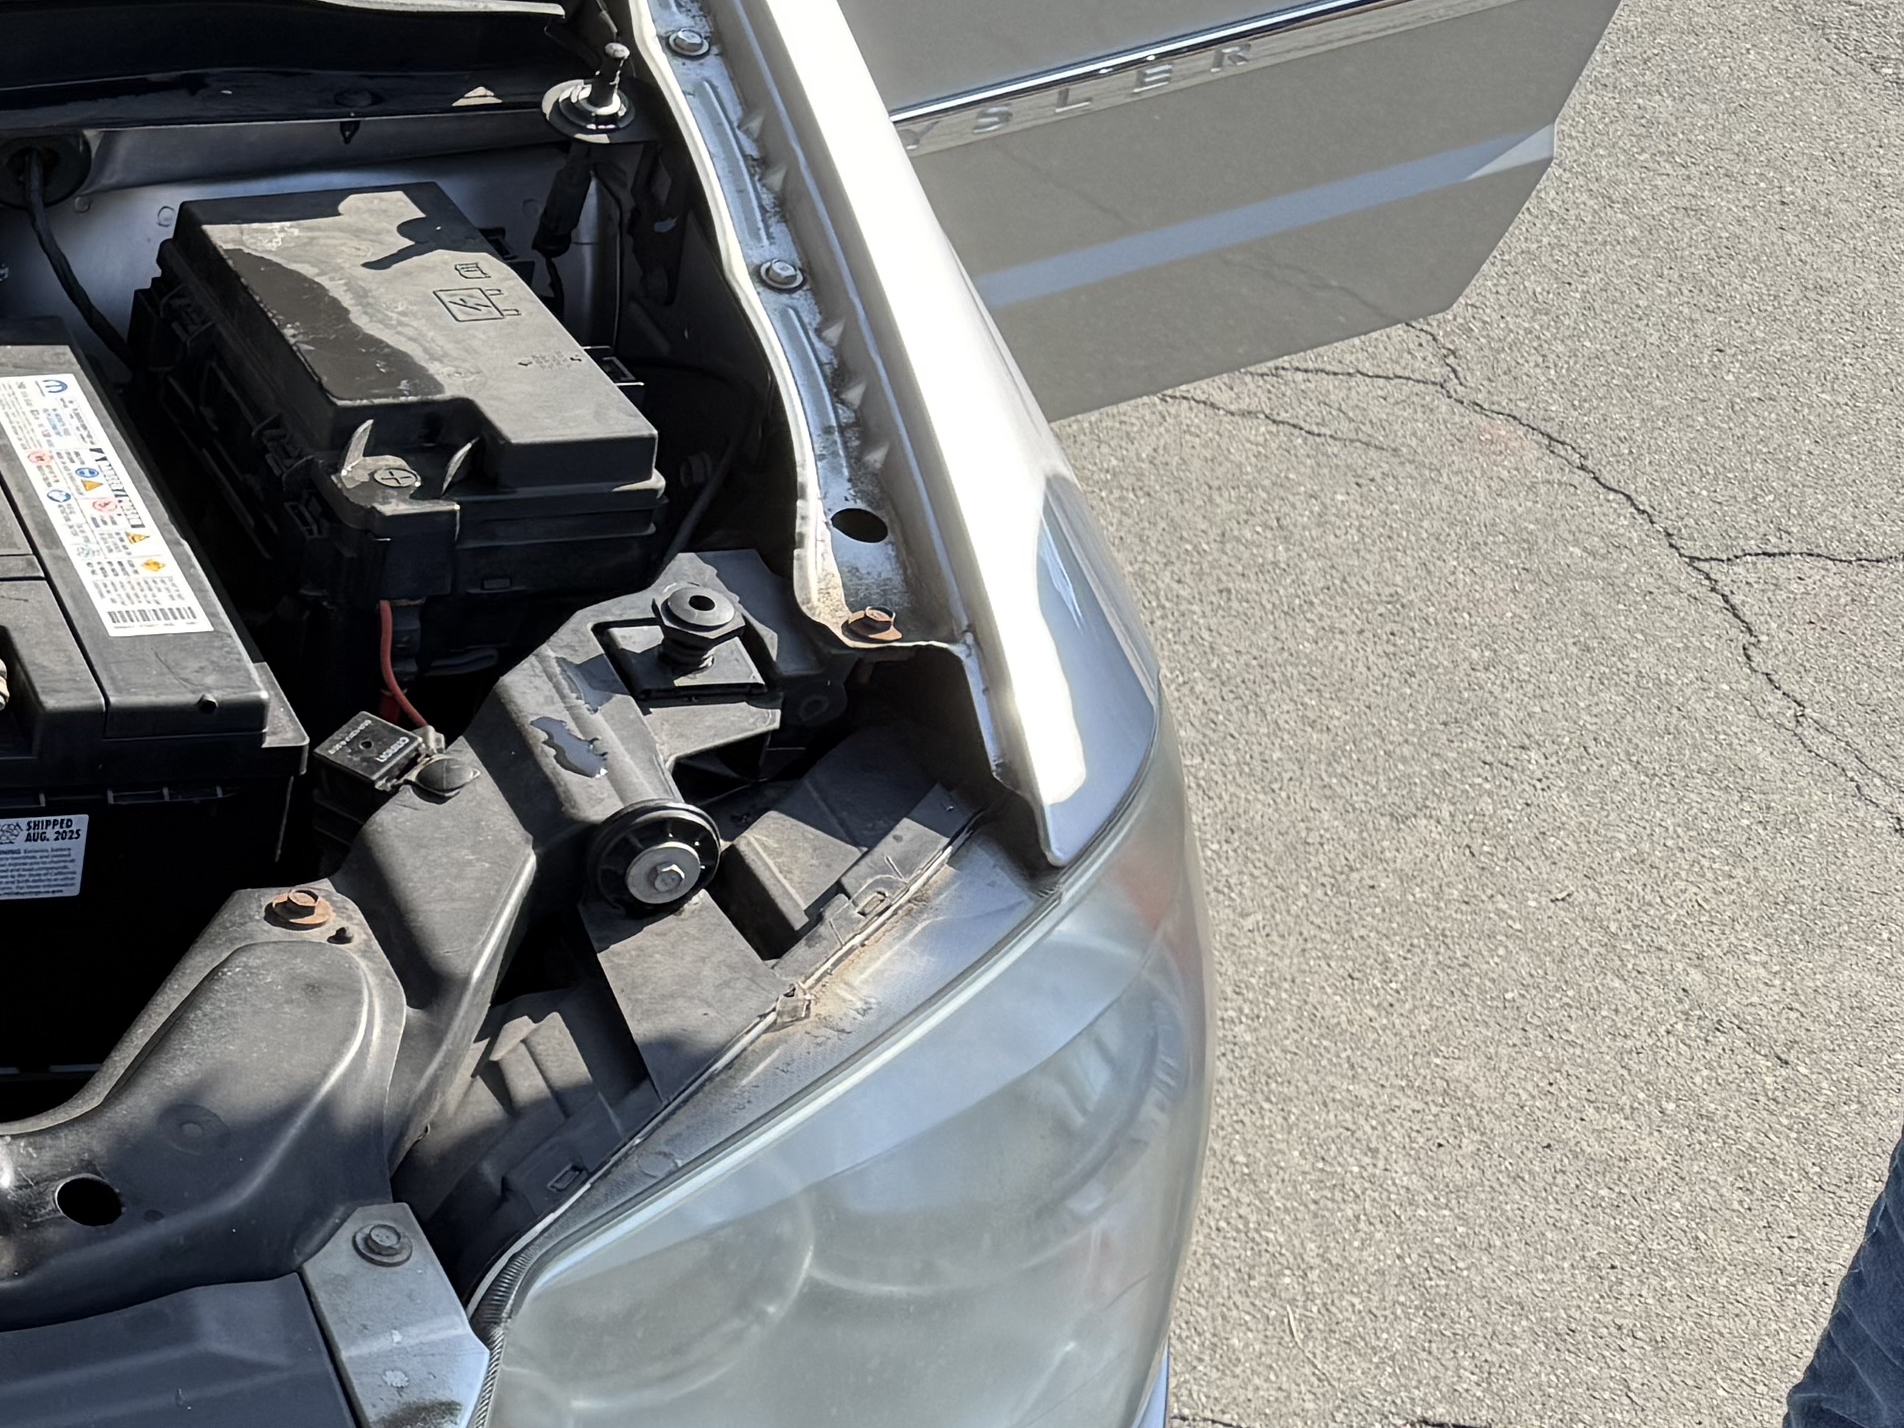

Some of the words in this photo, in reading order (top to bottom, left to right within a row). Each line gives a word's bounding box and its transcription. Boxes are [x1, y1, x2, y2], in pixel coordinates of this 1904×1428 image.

[26, 818, 73, 832] SHIPPED
[25, 831, 49, 843] AUG.
[53, 828, 82, 842] 2025
